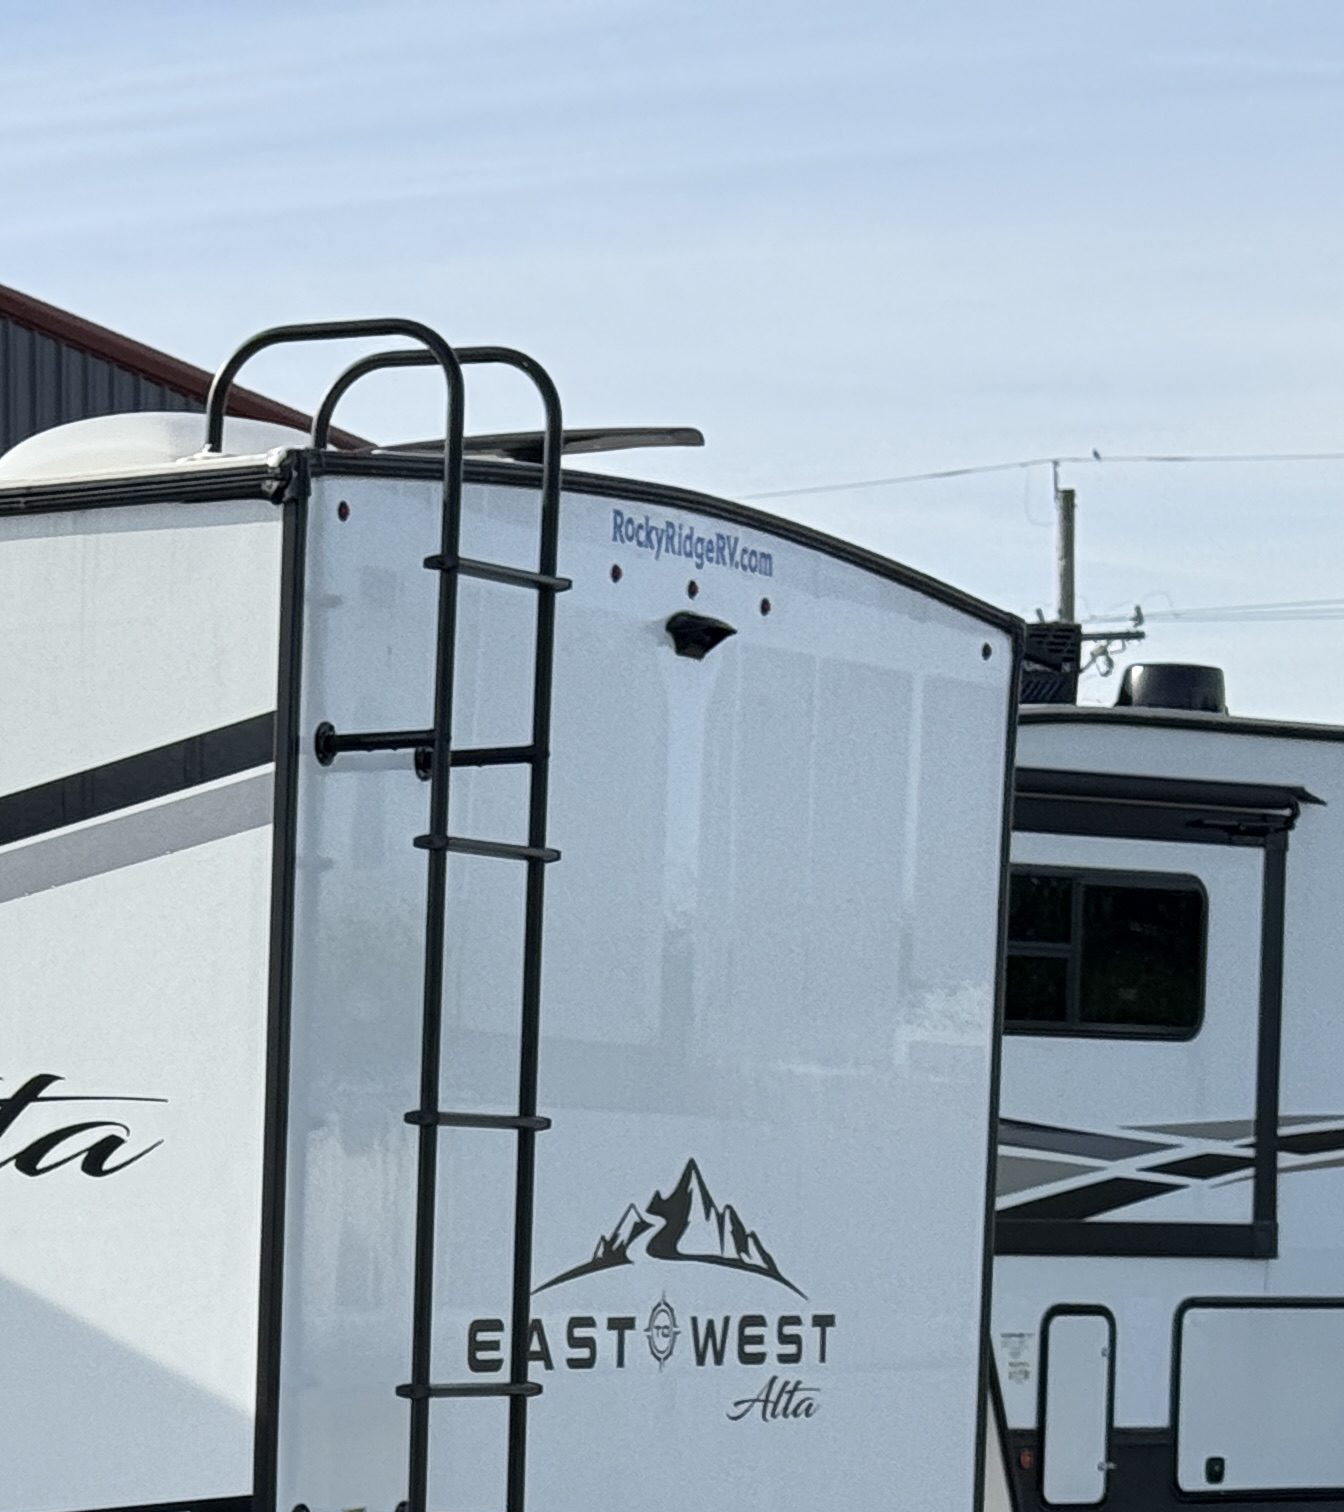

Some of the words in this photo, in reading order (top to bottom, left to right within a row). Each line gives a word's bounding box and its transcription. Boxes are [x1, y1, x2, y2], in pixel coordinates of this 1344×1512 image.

[611, 509, 774, 578] RockyRidgeRV.com
[467, 1315, 637, 1373] EAST
[690, 1313, 837, 1368] WEST
[726, 1375, 821, 1423] Alta
